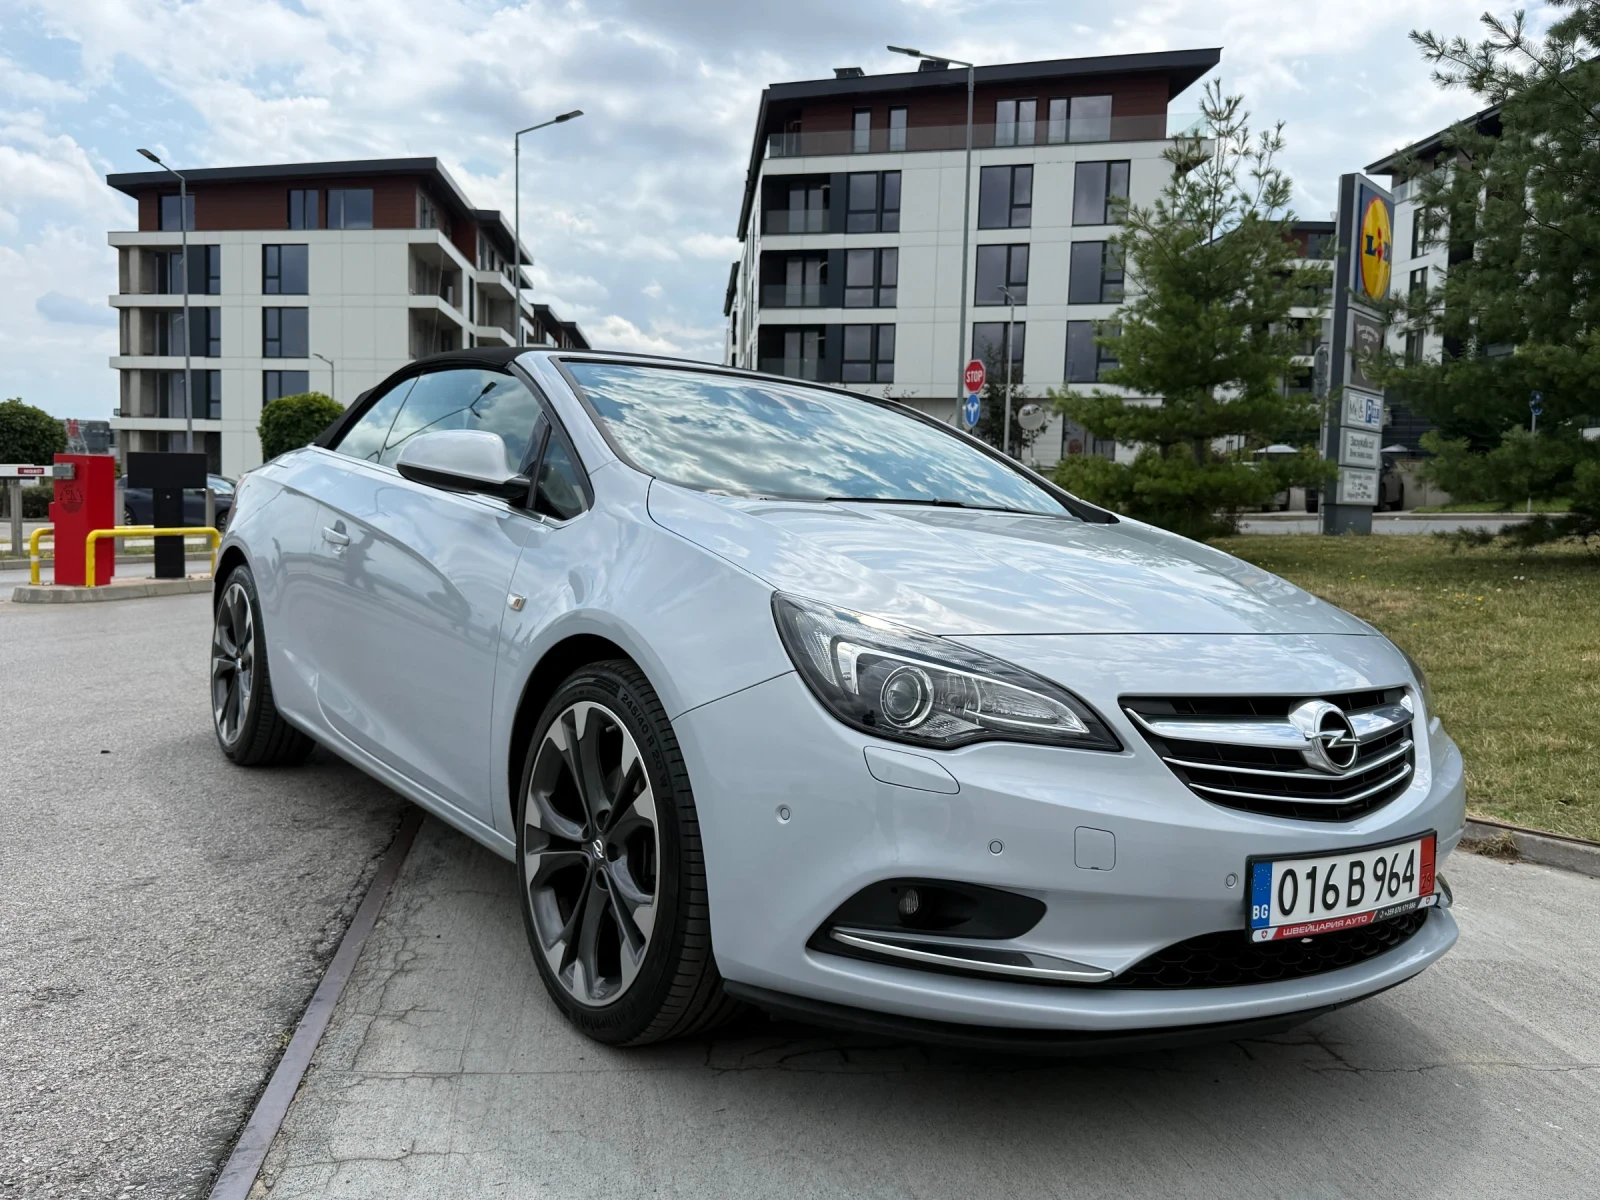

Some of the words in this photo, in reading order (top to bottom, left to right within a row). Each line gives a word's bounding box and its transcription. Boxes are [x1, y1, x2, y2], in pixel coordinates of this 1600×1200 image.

[966, 370, 983, 382] STOP
[621, 694, 649, 733] 245/40
[647, 738, 655, 747] R
[652, 749, 663, 770] 20
[1252, 904, 1269, 920] BG
[1282, 919, 1344, 936] ШВЕЙЦАРИЯ
[1345, 915, 1368, 926] АУТО
